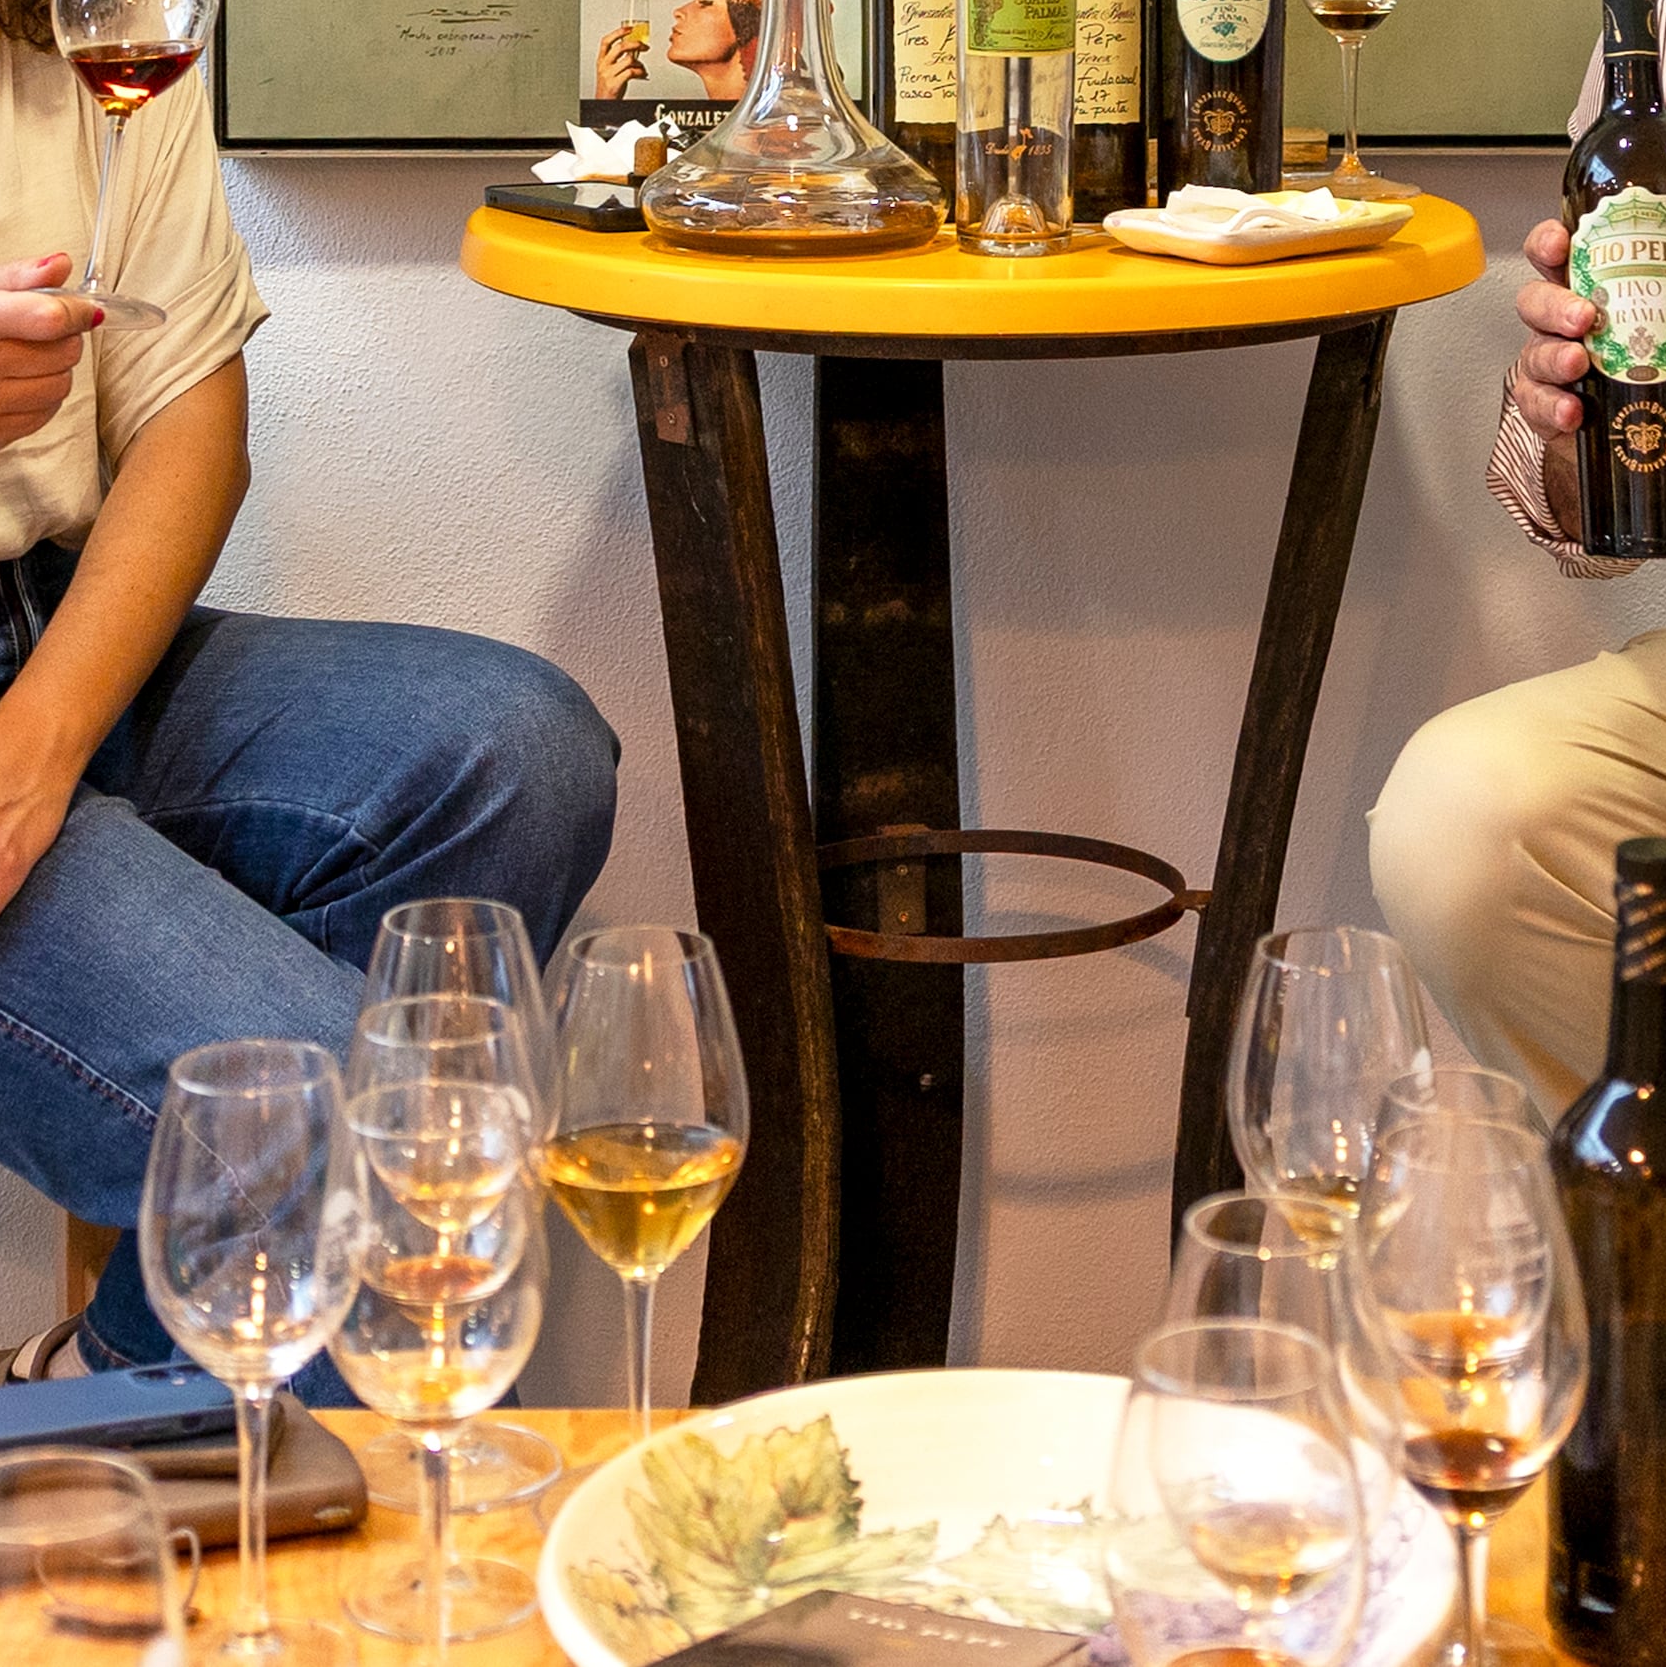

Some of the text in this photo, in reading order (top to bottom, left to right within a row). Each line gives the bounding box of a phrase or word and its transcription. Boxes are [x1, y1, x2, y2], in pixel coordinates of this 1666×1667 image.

[897, 24, 929, 47] Tres
[1079, 23, 1126, 48] Pepe
[1588, 241, 1624, 268] TIO
[1615, 307, 1666, 324] RAMA
